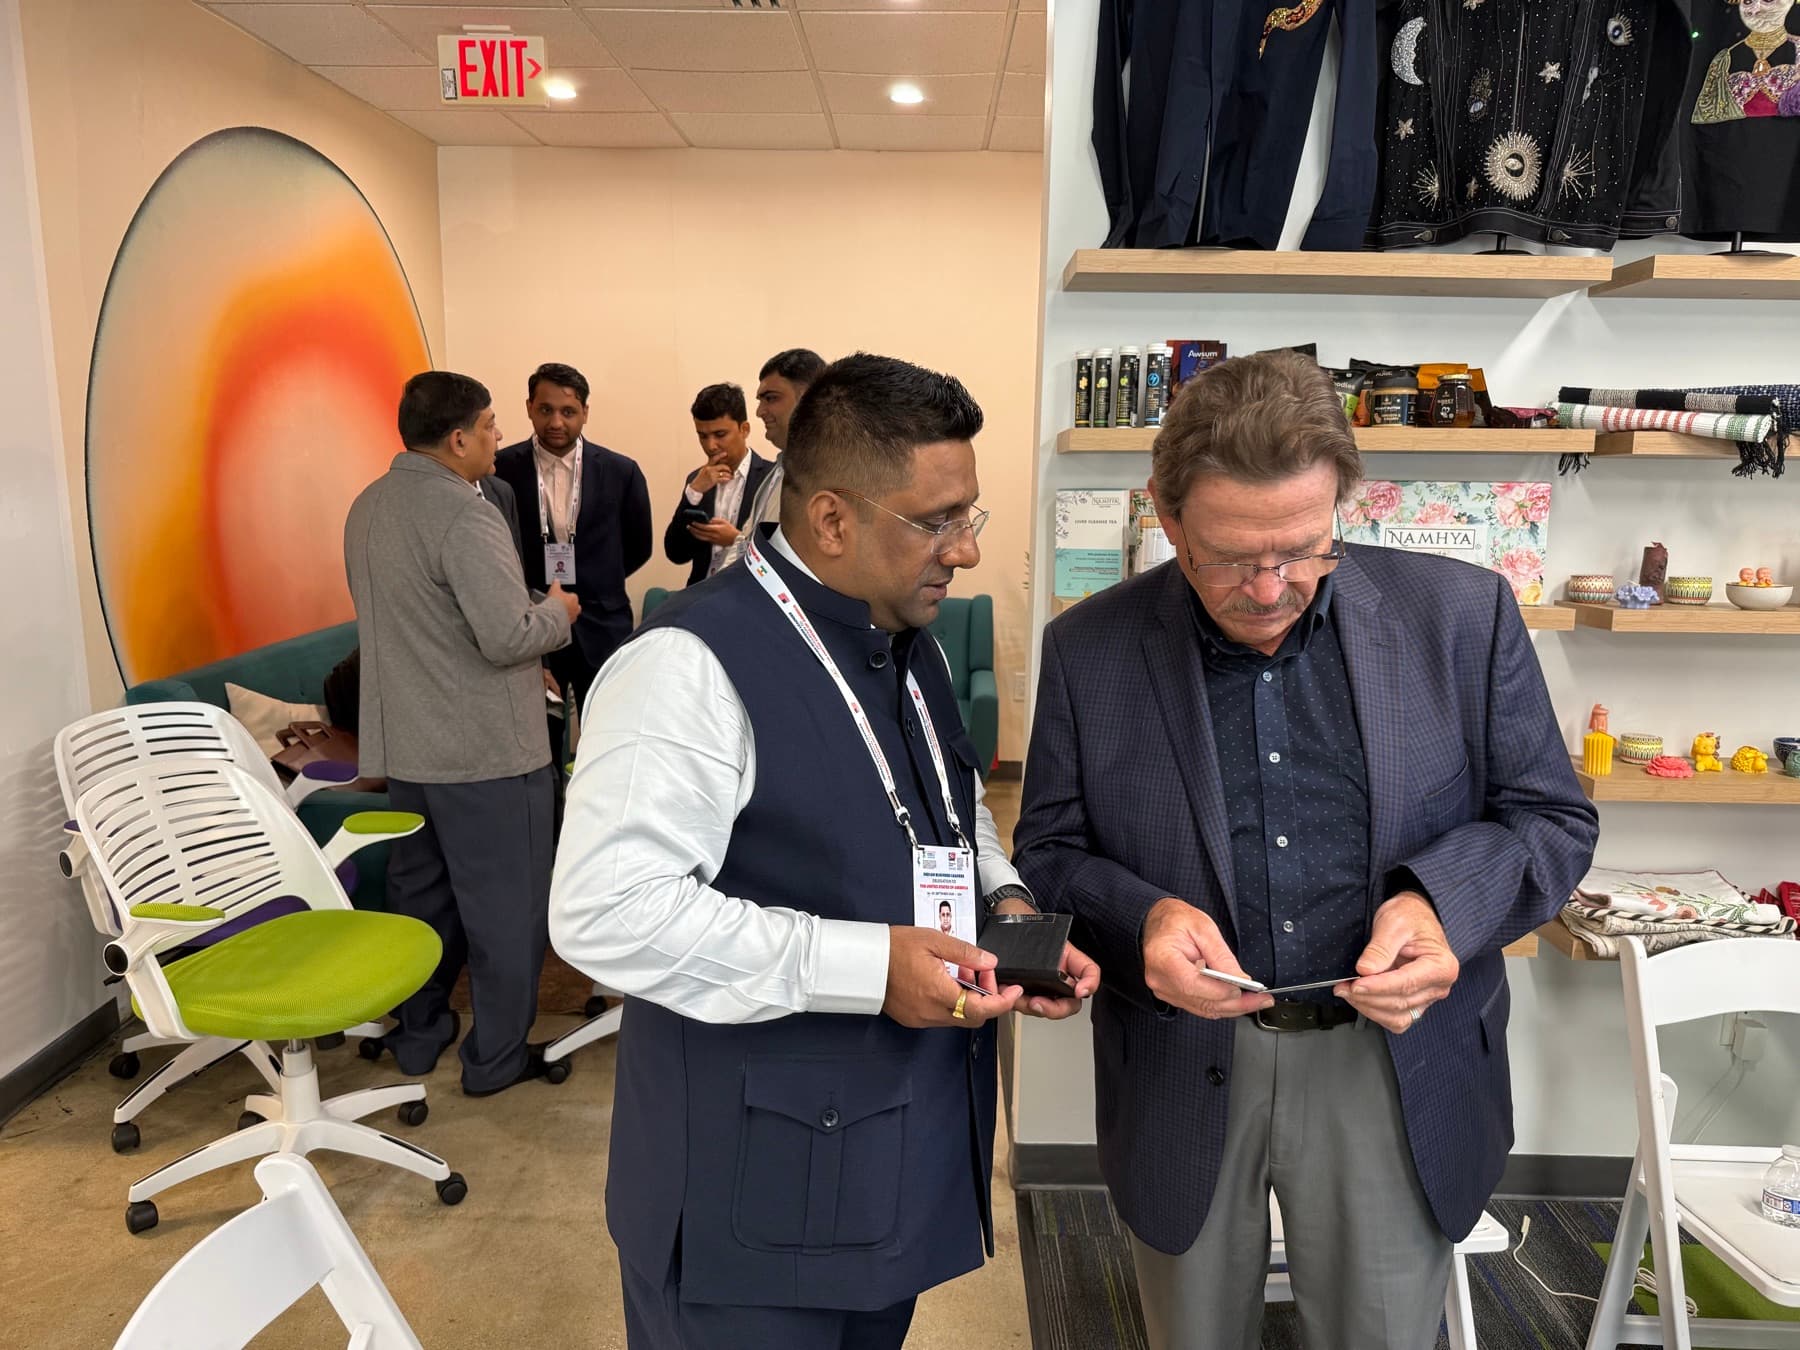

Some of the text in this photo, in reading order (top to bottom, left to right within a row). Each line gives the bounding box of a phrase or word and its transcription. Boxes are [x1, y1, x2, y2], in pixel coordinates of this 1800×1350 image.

[458, 40, 528, 97] EXIT
[1187, 350, 1218, 358] Awsum
[1333, 381, 1356, 390] oodles
[1388, 530, 1472, 547] NAMHYA
